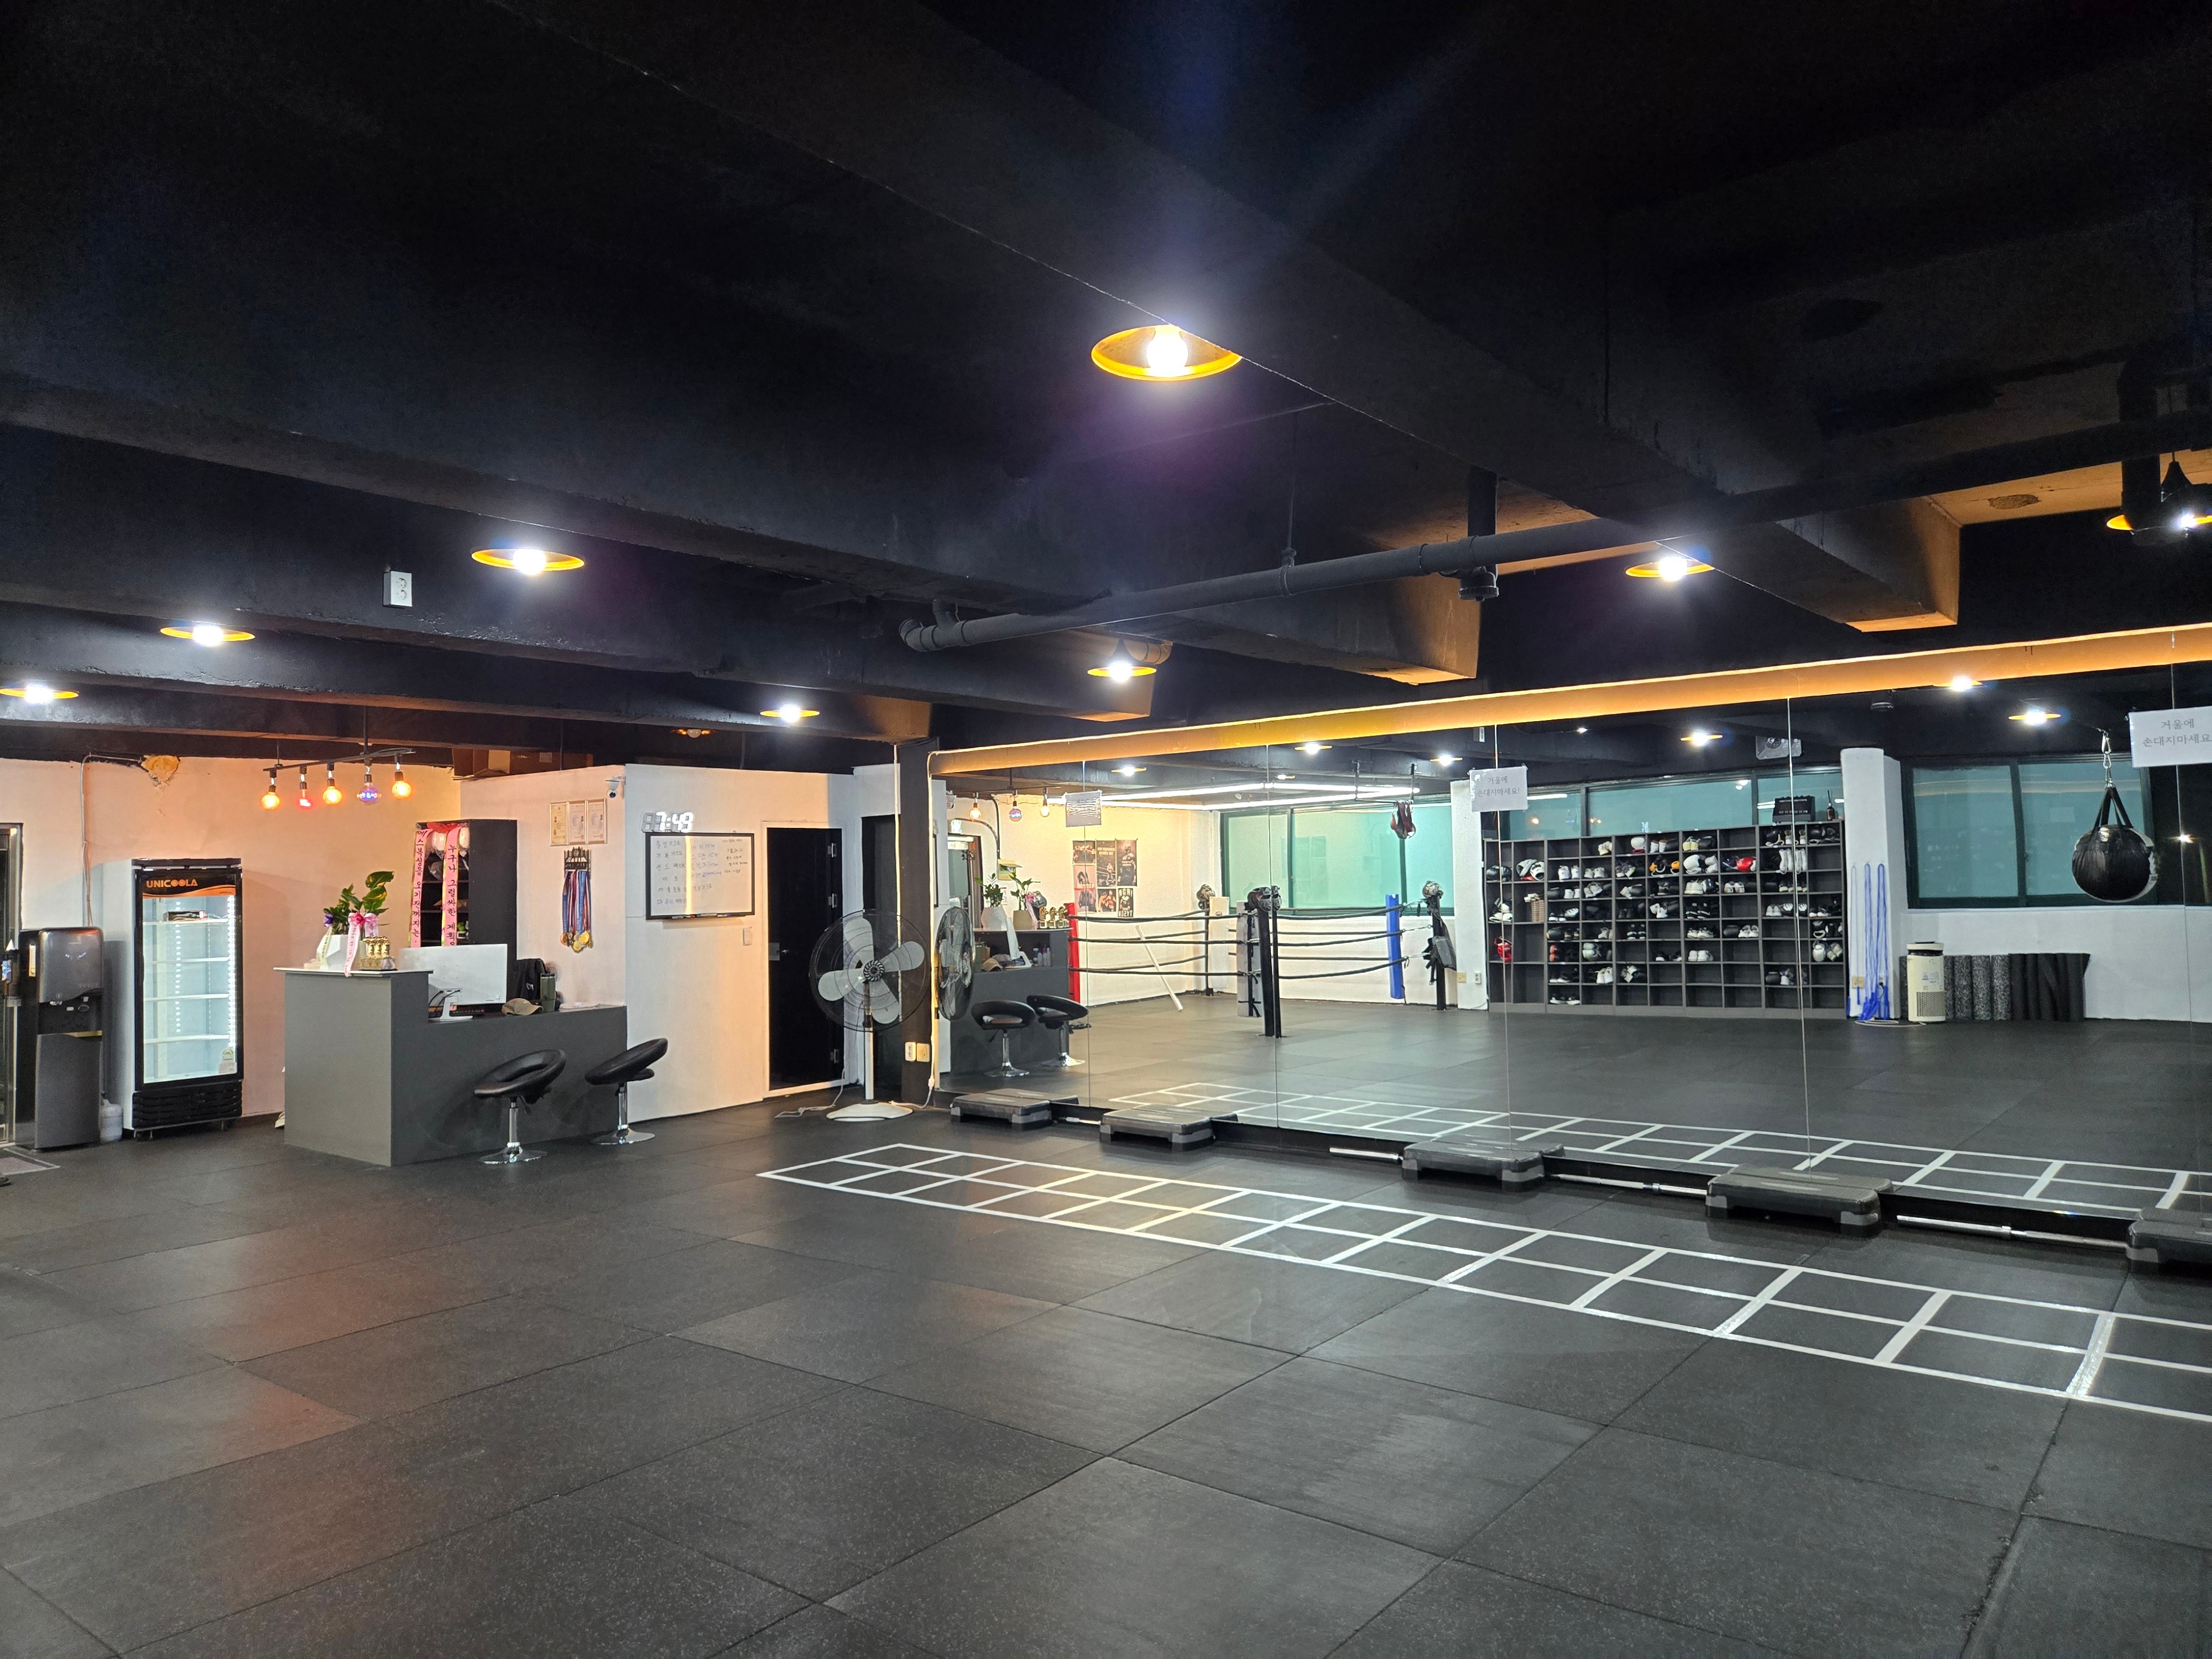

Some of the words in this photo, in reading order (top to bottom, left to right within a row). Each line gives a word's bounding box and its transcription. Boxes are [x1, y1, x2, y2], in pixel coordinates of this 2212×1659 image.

[2161, 718, 2194, 730] 거울에
[2142, 734, 2212, 747] 손대지마세요
[1488, 776, 1508, 785] 거울에
[1477, 787, 1520, 797] 손대지마세요!
[656, 812, 693, 832] 7:49
[415, 830, 428, 875] 에스복싱을
[447, 845, 457, 873] 누구나
[146, 879, 198, 888] UNICOOLA
[447, 880, 457, 917] 그럴싸한
